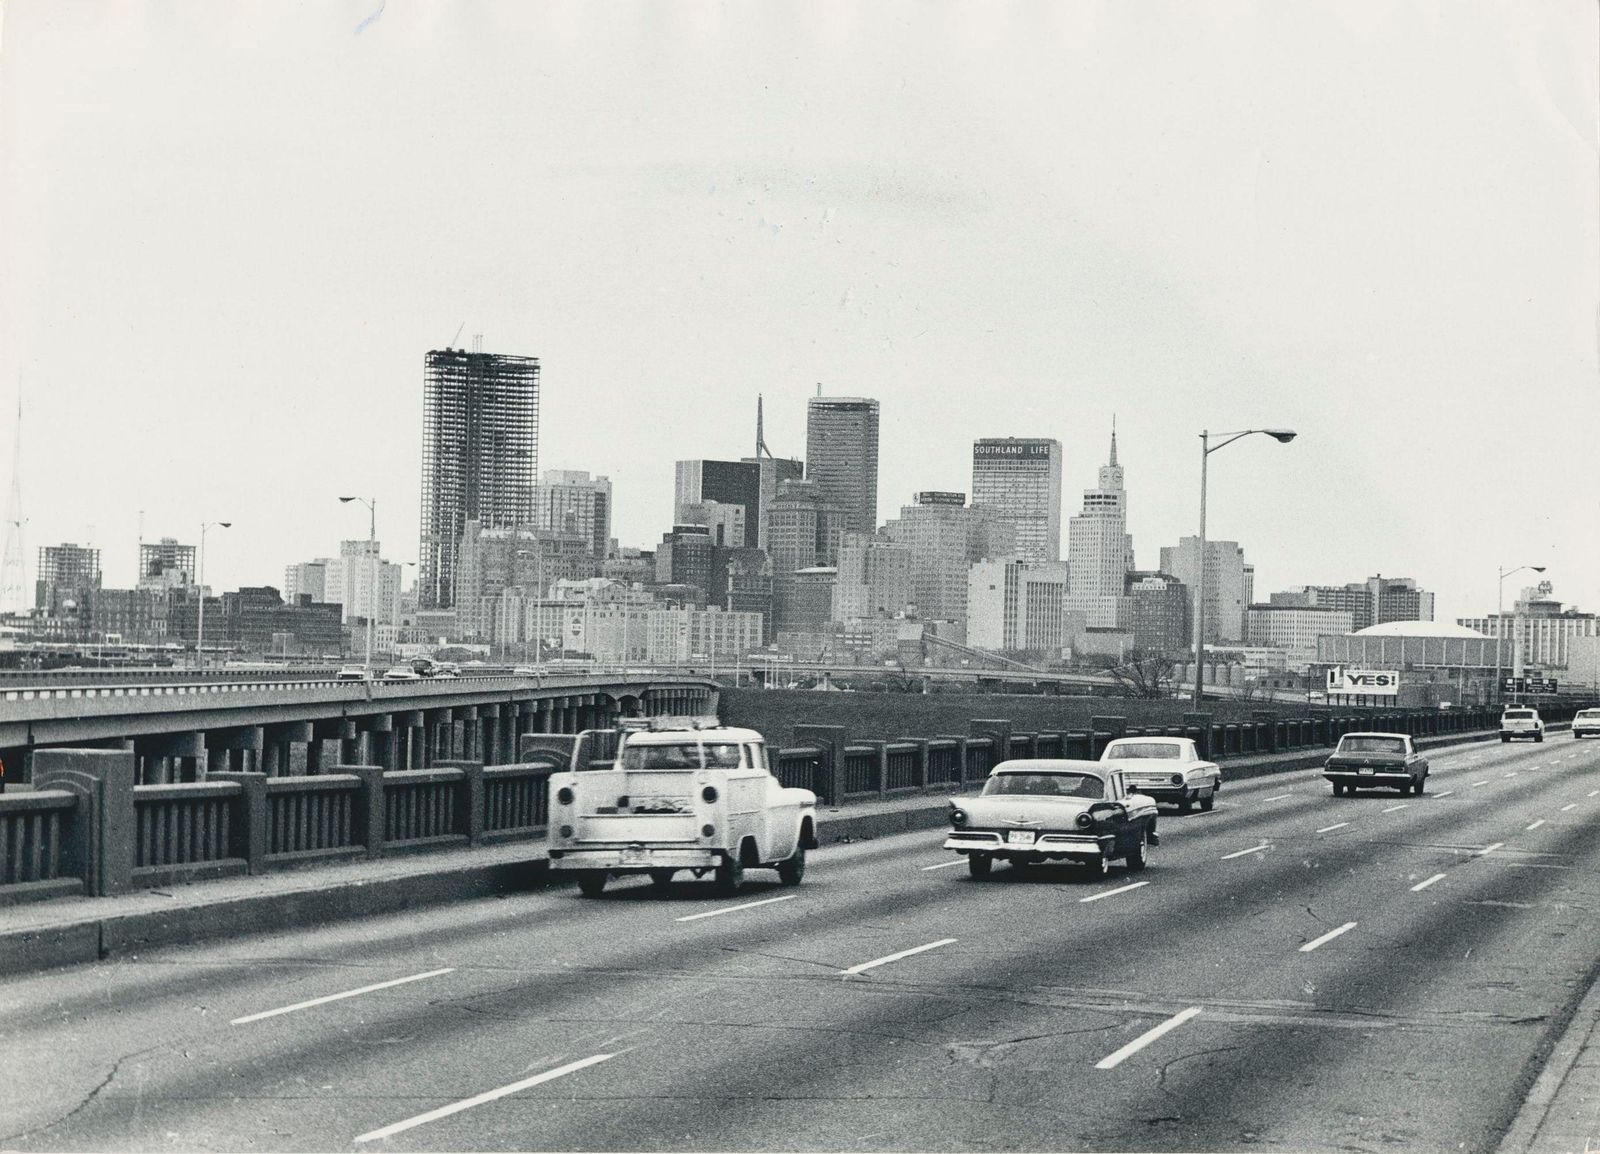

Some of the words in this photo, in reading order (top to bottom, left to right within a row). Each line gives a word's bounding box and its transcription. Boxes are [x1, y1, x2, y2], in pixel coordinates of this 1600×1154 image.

[974, 446, 1023, 454] SOUTHLAND
[1030, 446, 1049, 454] LIFE
[1346, 674, 1396, 686] YES!
